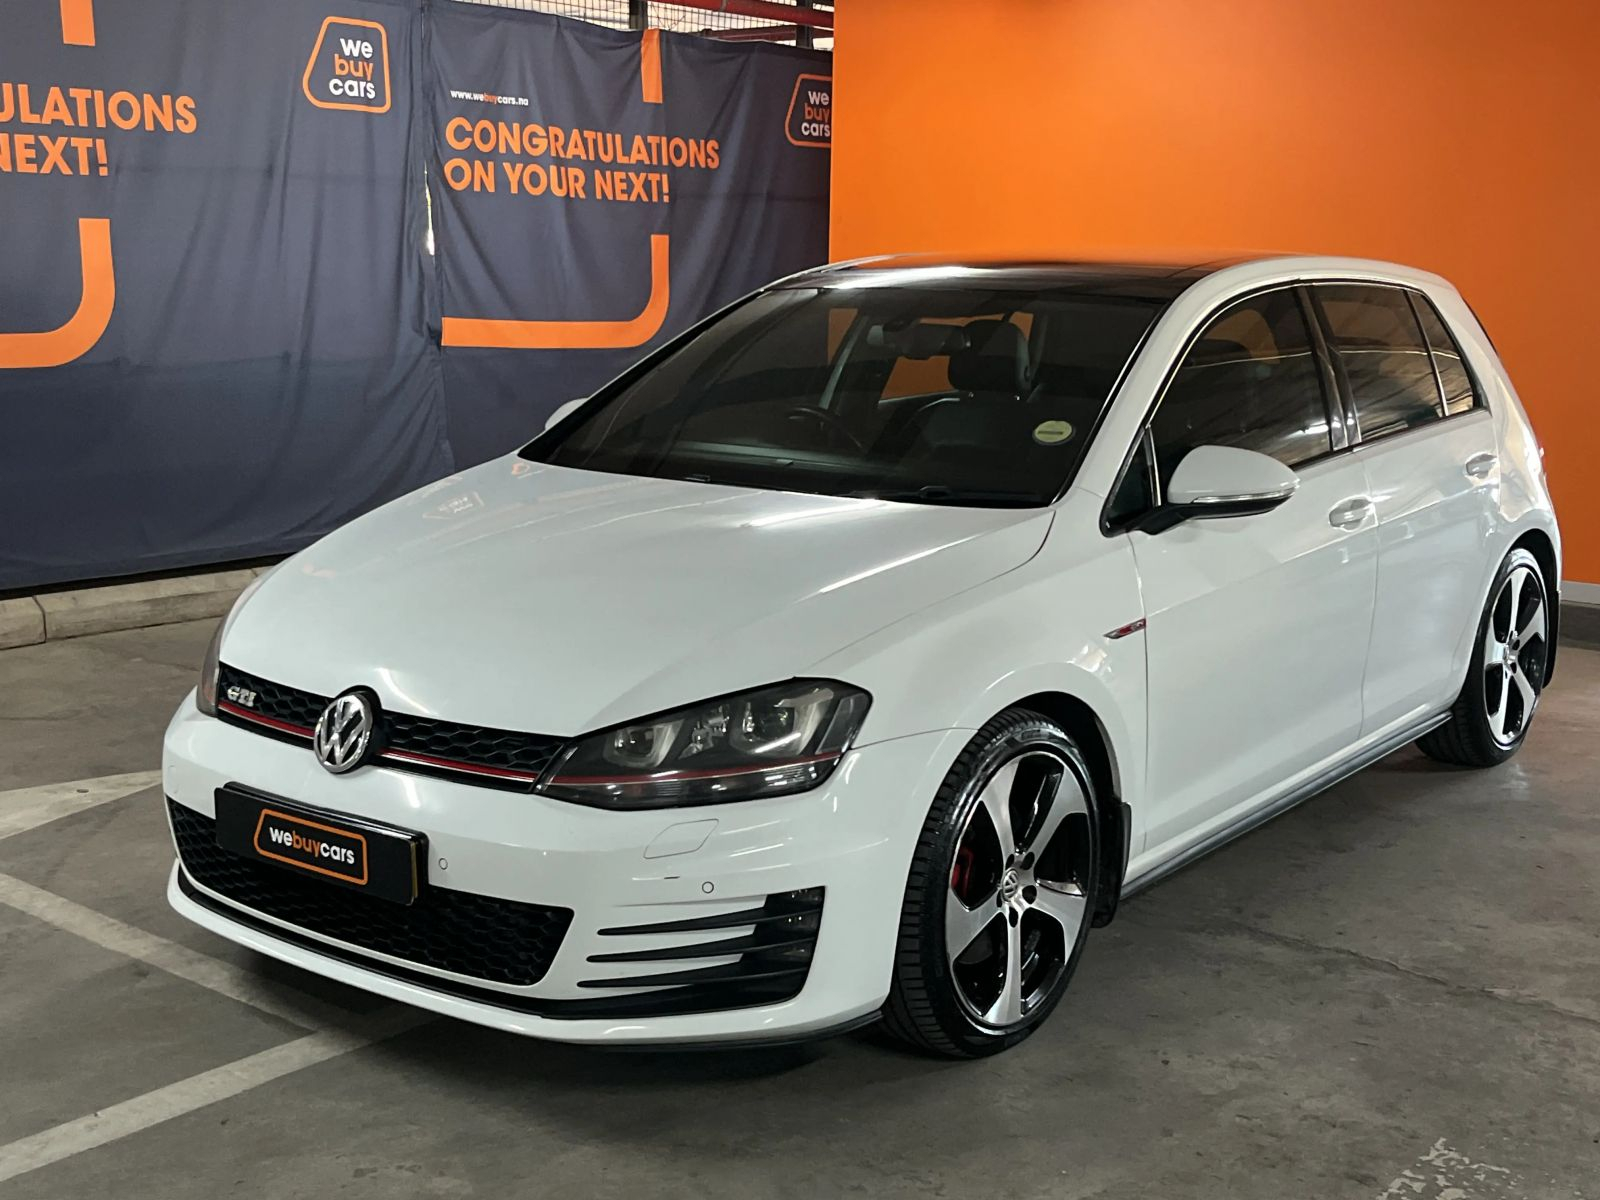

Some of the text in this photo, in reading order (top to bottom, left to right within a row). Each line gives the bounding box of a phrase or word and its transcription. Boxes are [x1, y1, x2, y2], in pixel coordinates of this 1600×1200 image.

[339, 38, 373, 58] we
[334, 53, 374, 81] buy
[328, 78, 376, 99] cars
[450, 89, 529, 106] www.webuycars.na
[807, 90, 830, 106] we
[804, 102, 831, 123] buy
[801, 122, 832, 137] cars
[445, 116, 720, 169] CONGRATULATIONS
[443, 157, 670, 203] ON YOUR NEXT!
[227, 685, 257, 707] GTI
[269, 826, 355, 865] webuycars
